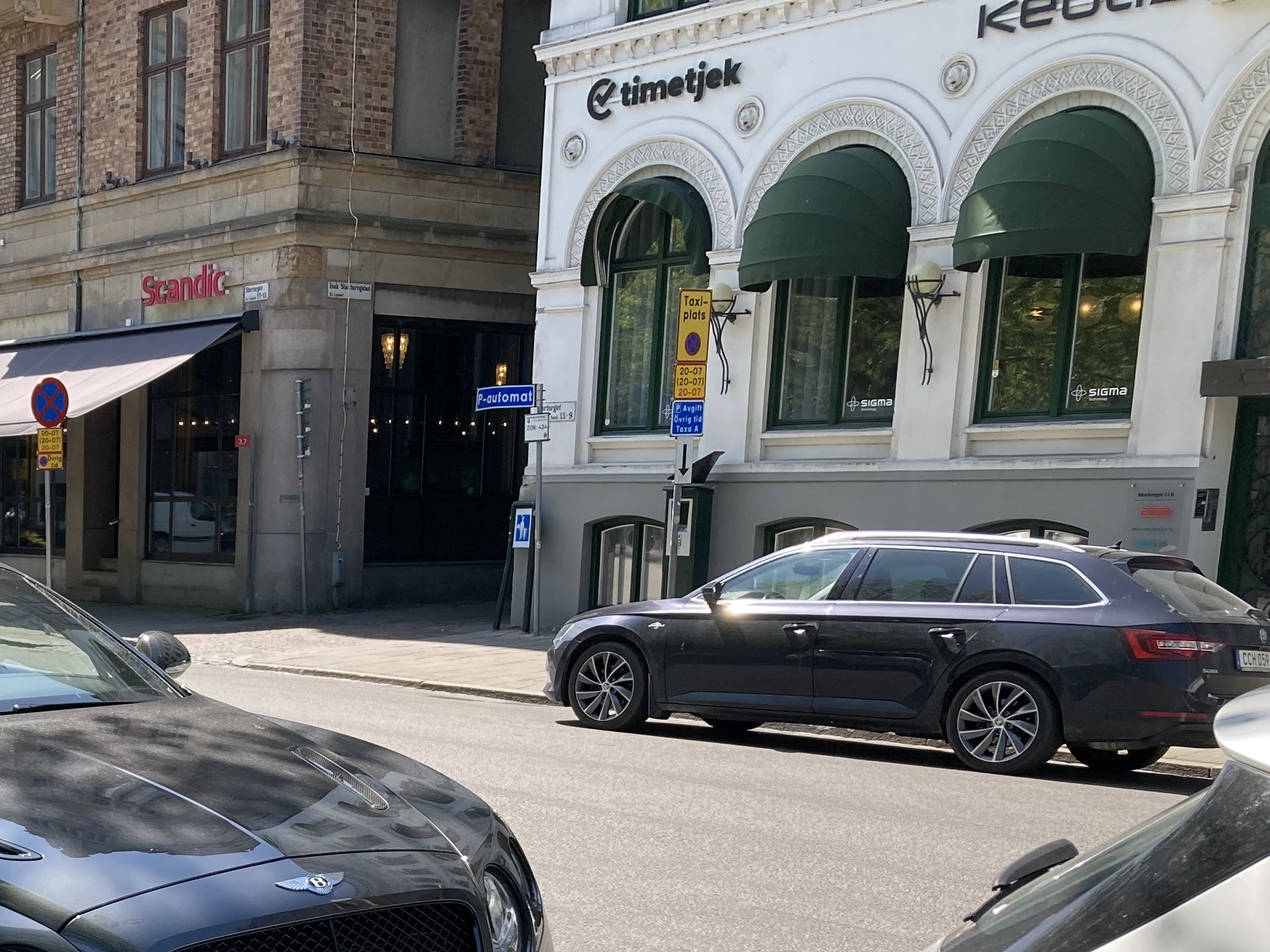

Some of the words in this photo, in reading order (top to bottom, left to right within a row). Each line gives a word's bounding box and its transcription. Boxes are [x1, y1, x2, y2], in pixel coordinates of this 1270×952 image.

[620, 58, 742, 107] timetjek
[142, 263, 226, 306] Scandic
[683, 295, 709, 307] Taxi-
[683, 310, 706, 322] plats
[679, 367, 703, 376] 20-07
[676, 377, 705, 387] (20-07)
[477, 390, 533, 405] P-automat
[678, 388, 702, 397] 20-07
[682, 404, 703, 414] Avgift
[673, 415, 692, 424] Övrig
[693, 415, 703, 423] tid
[676, 425, 693, 433] Taxa
